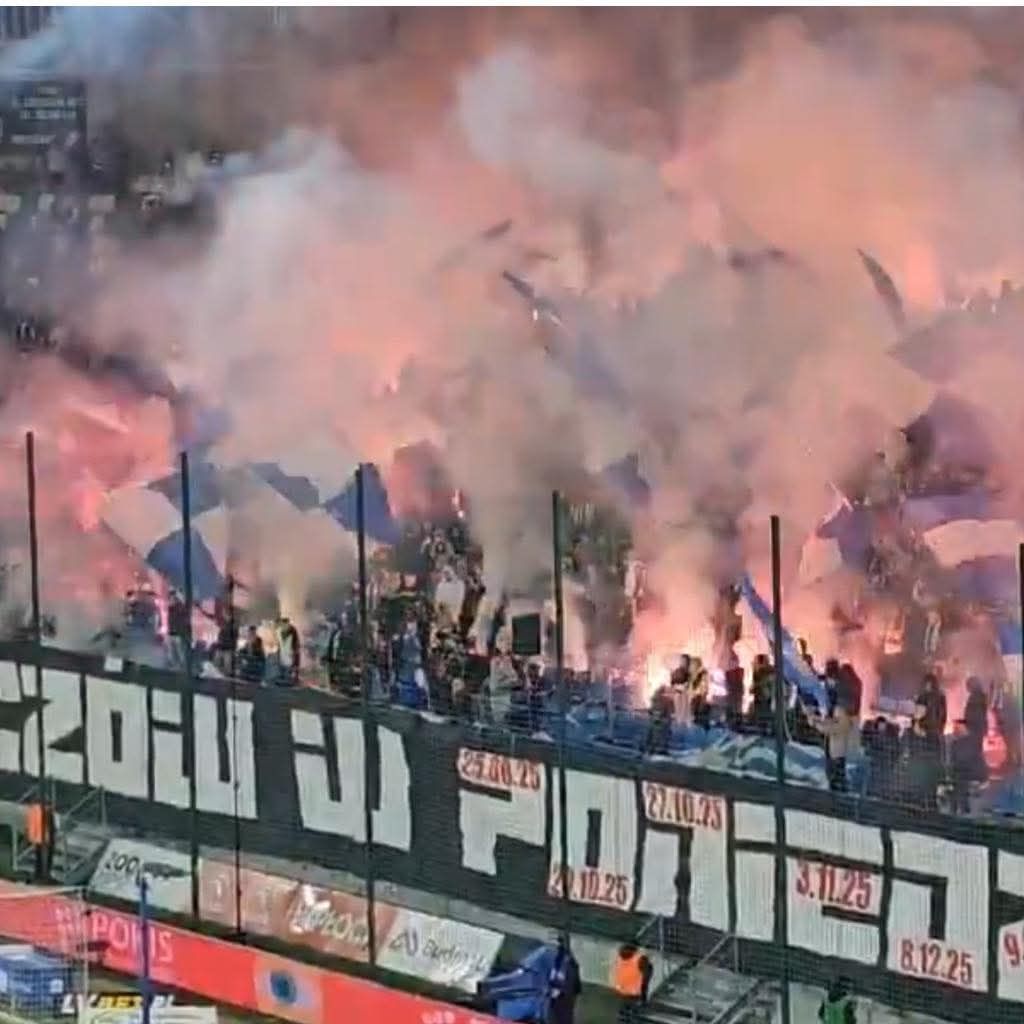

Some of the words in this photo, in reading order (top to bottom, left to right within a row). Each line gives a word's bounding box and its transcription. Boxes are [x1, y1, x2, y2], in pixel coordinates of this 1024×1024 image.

[645, 781, 722, 829] 27.10.25
[796, 861, 873, 910] 3.11.25
[901, 938, 974, 984] 8.12.25
